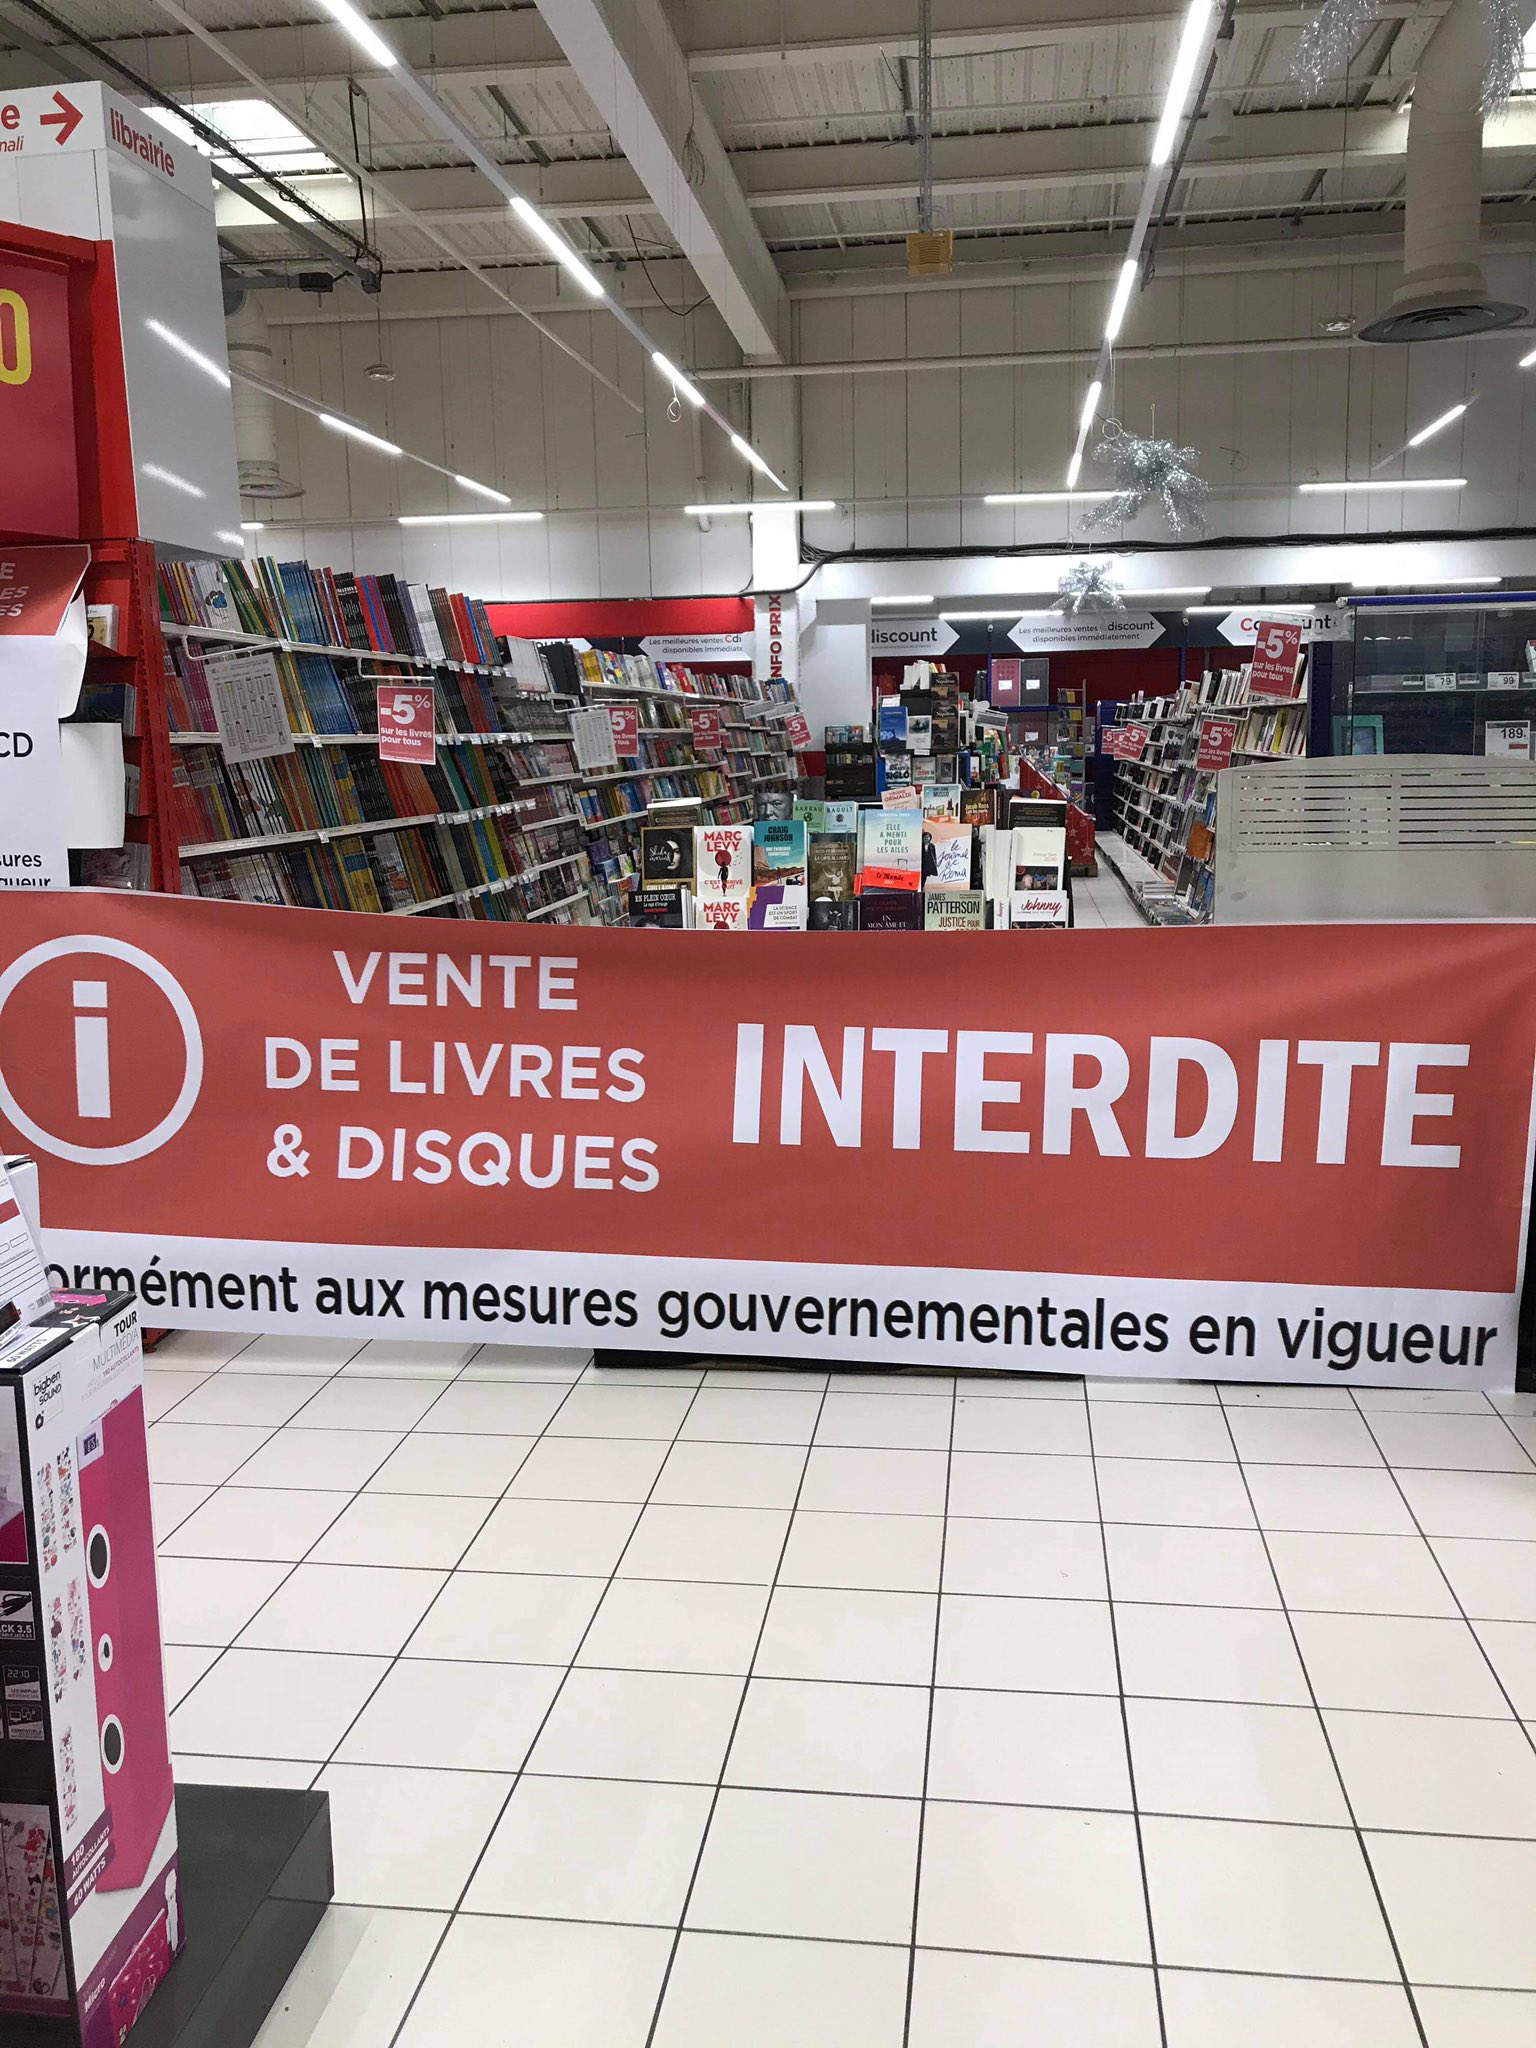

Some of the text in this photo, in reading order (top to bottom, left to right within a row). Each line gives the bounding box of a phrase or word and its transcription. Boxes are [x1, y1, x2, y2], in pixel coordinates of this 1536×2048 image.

[111, 108, 175, 177] librairie
[1107, 620, 1155, 632] discount
[649, 638, 661, 646] Les
[662, 638, 700, 646] meilleures
[769, 594, 783, 678] NFO PRIX
[1032, 633, 1140, 643] disponibles immédiatement
[662, 646, 704, 655] disponibles
[1265, 661, 1275, 671] les
[1275, 664, 1294, 674] livres
[1252, 670, 1284, 681] pour tous
[380, 694, 431, 725] -5%
[381, 727, 432, 738] sur les livres
[381, 736, 422, 746] pour tous
[886, 823, 901, 831] ELLE
[704, 831, 742, 841] MARC
[764, 834, 793, 843] JOHNSON
[706, 842, 740, 852] LEVY
[703, 902, 740, 912] MARC
[927, 901, 980, 914] PATTERSON
[1021, 898, 1062, 917] Johnny
[706, 913, 738, 923] LEVY
[938, 917, 966, 928] JUSTICE
[333, 950, 579, 1011] VENTE
[264, 1036, 647, 1103] DE LIVRES
[732, 1022, 1470, 1169] INTERDITE
[266, 1123, 661, 1193] & DISQUES
[114, 1311, 138, 1337] TOUR
[316, 1276, 406, 1318] aux
[423, 1280, 638, 1328] mesures
[657, 1287, 1170, 1352] gouvernementales
[1189, 1314, 1256, 1356] en
[1277, 1307, 1498, 1371] vigueur
[33, 1371, 61, 1396] bigben
[39, 1384, 63, 1406] SOUND
[0, 1624, 32, 1634] CK 3.5
[71, 1844, 85, 1865] 180
[72, 1826, 111, 1877] AUTOCOLLANTS
[73, 1858, 107, 1906] 60 WATTS
